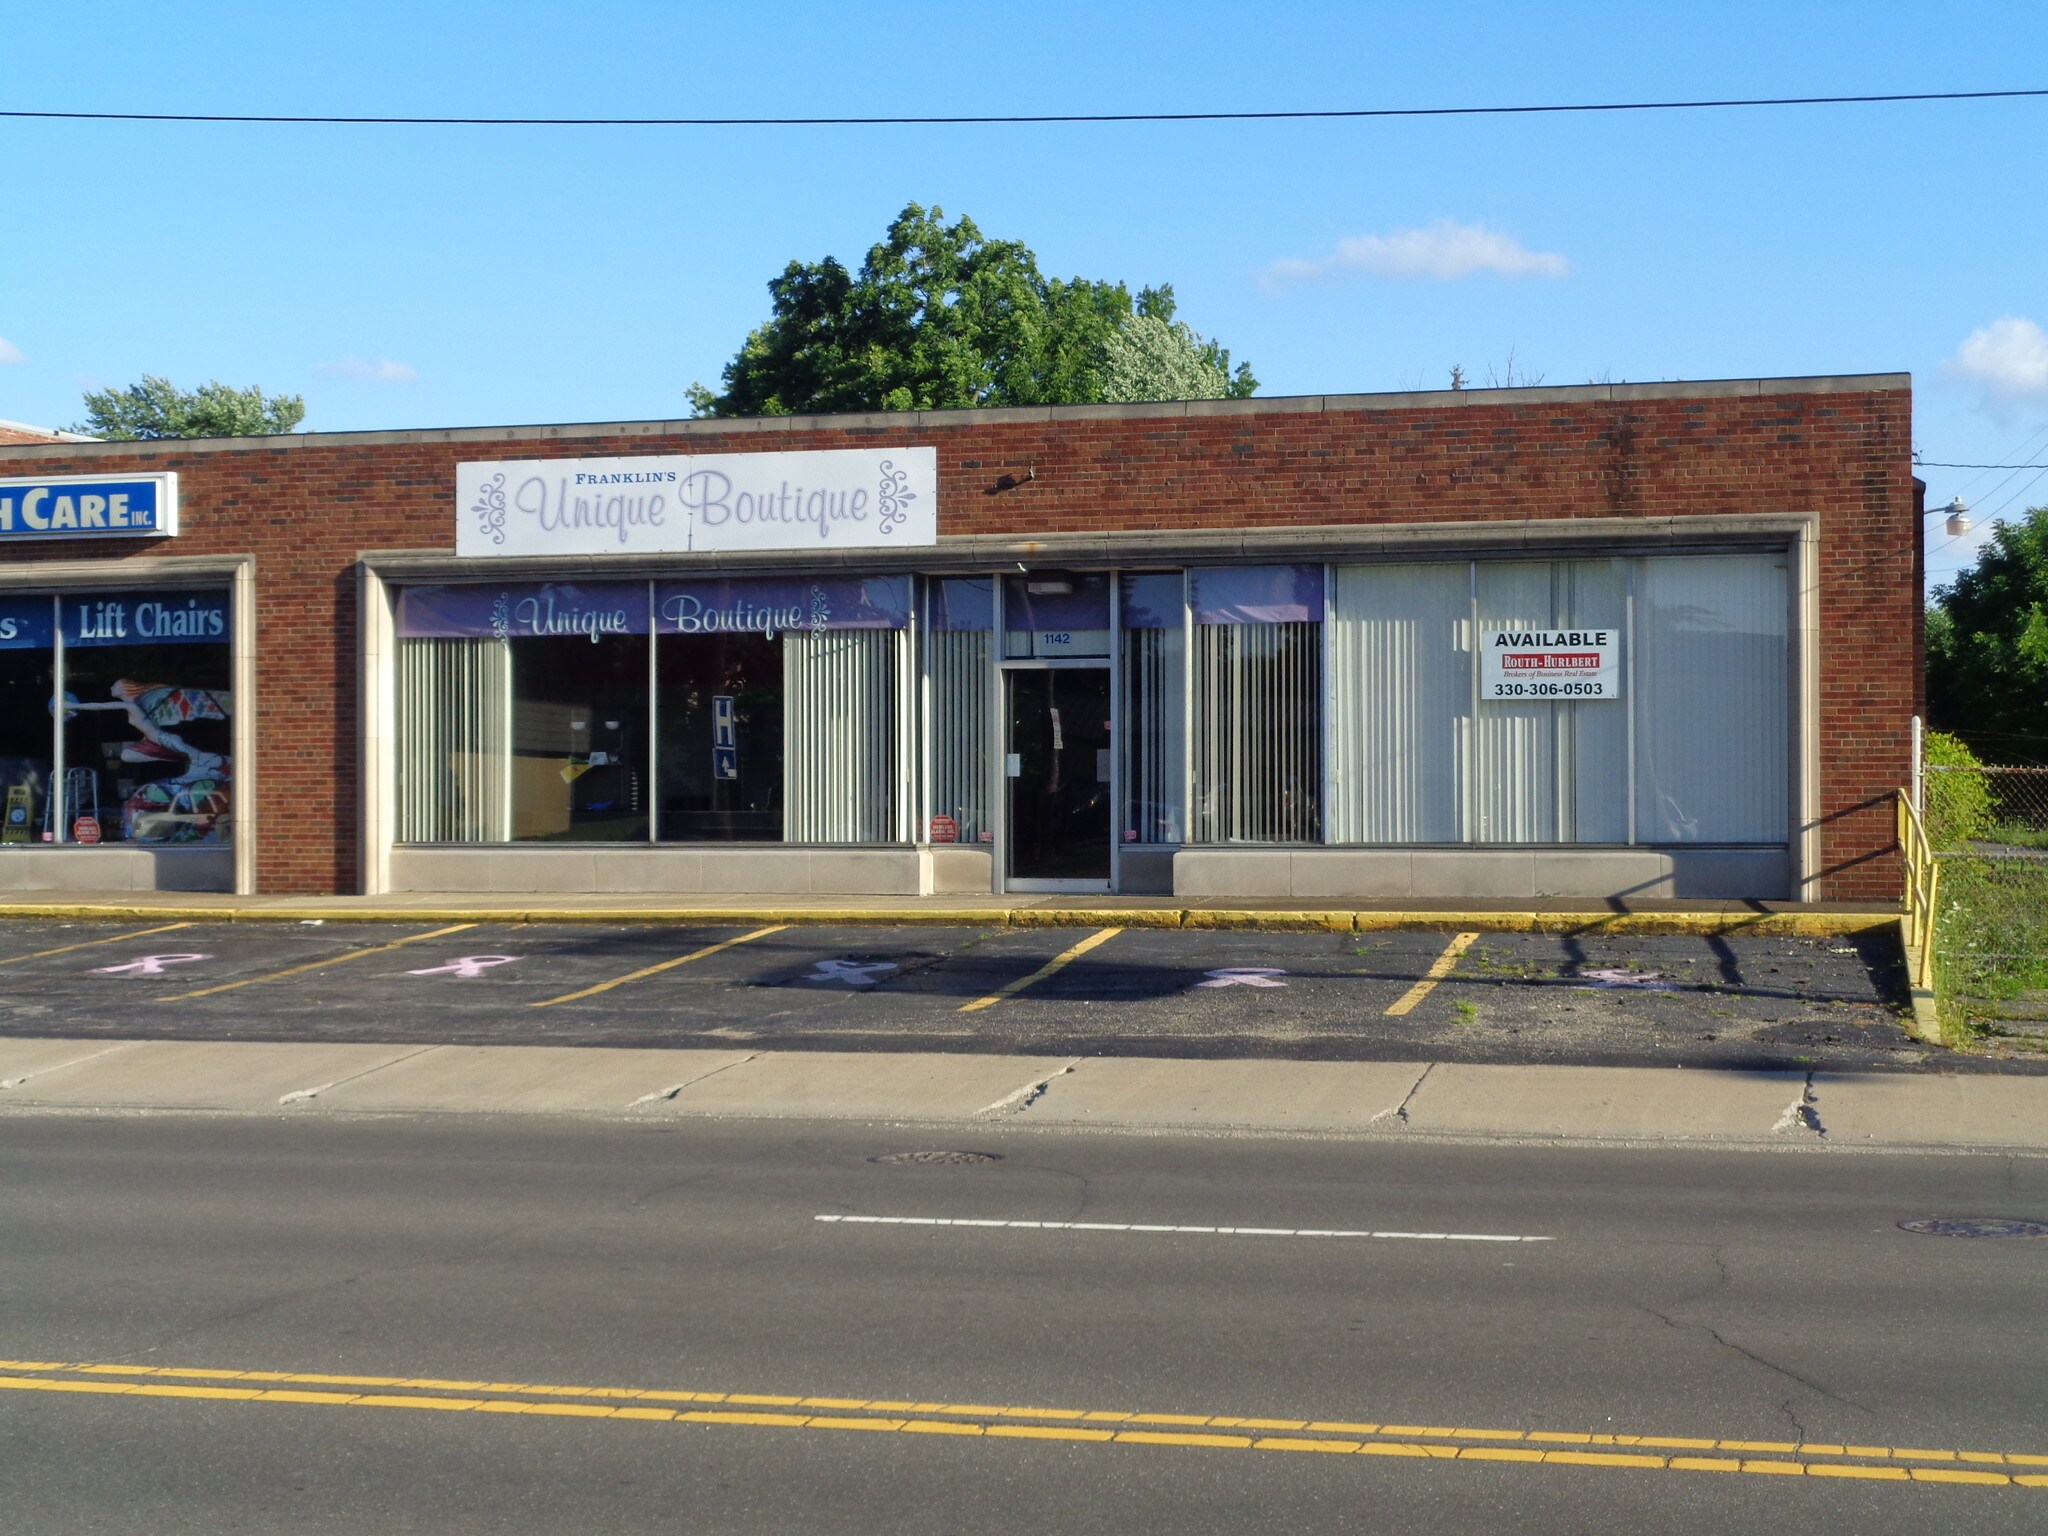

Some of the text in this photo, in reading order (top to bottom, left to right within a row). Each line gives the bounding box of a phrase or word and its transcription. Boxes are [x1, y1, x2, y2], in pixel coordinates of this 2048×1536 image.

[576, 471, 677, 485] FRANKLIN'S
[21, 487, 128, 530] CARE
[131, 511, 152, 526] INC.
[515, 469, 869, 543] Unique Boutique
[79, 599, 224, 639] Lift Chairs
[514, 594, 802, 643] Unique Boutique
[1044, 633, 1070, 644] 1142
[1495, 633, 1607, 647] AVAILABLE
[1495, 683, 1603, 696] 330-306-0503
